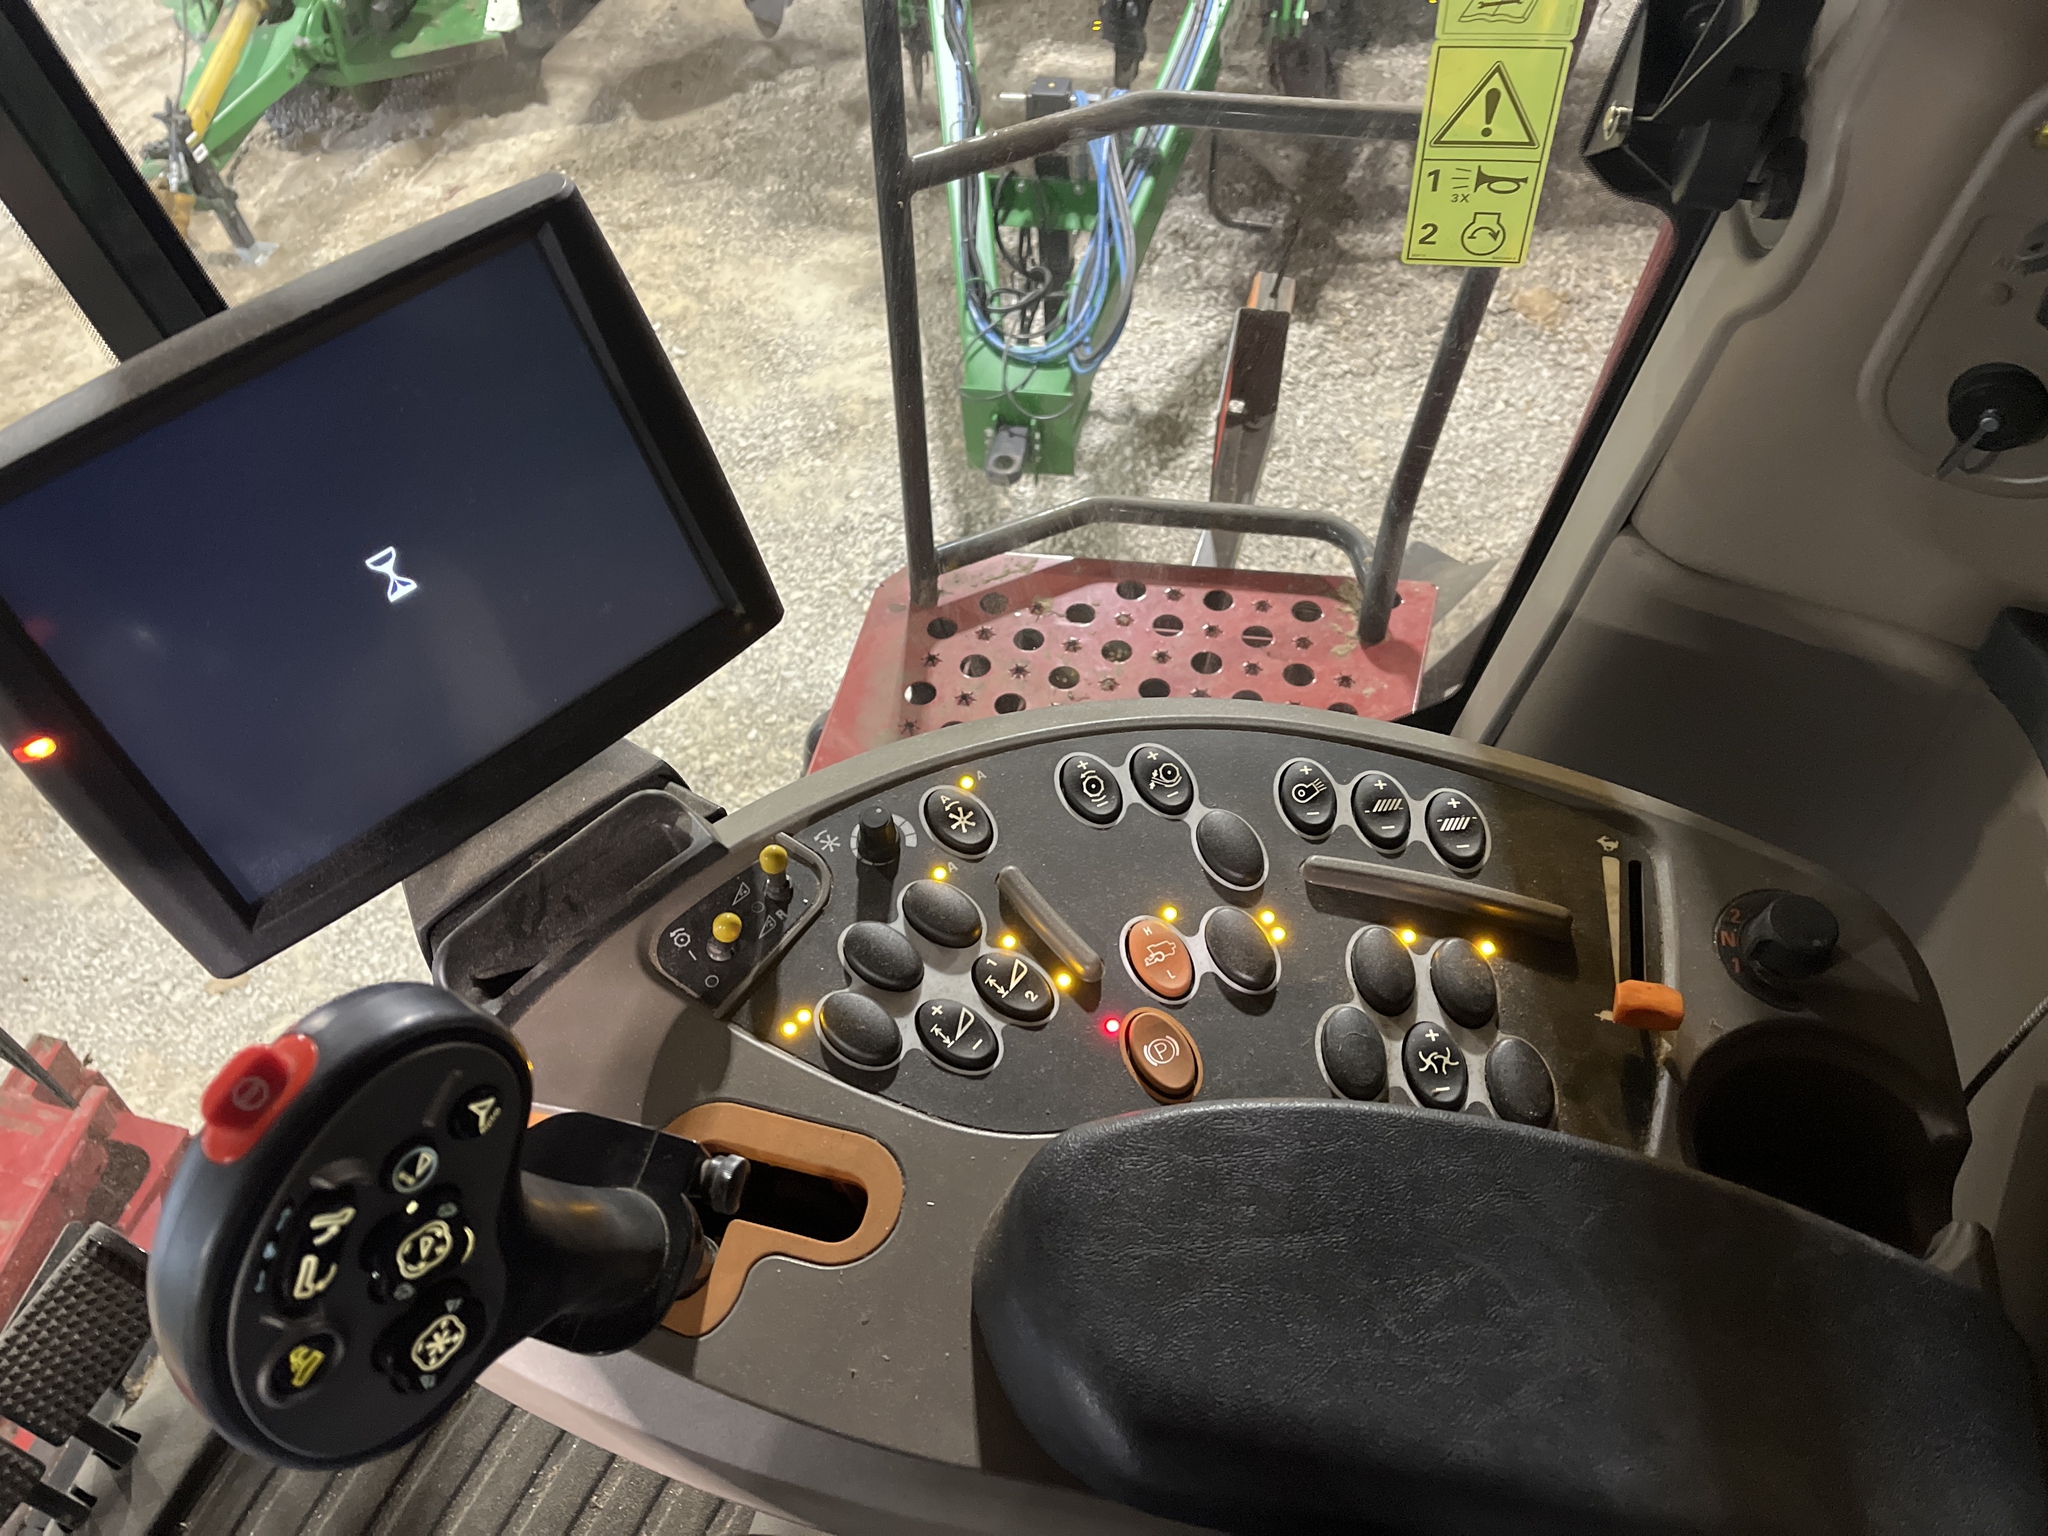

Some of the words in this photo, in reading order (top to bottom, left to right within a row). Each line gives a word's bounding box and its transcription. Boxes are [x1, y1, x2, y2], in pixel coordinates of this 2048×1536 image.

[1427, 168, 1441, 192] 1
[1451, 193, 1470, 203] 3X
[1418, 223, 1438, 245] 2
[977, 770, 987, 780] A
[940, 794, 951, 804] A
[947, 861, 958, 873] A
[775, 909, 788, 920] R
[1730, 908, 1741, 924] 2
[1143, 926, 1153, 936] H
[1720, 930, 1736, 947] N
[986, 958, 998, 967] 1
[1732, 957, 1740, 973] 1
[1166, 969, 1176, 979] L
[1025, 990, 1038, 1003] 2
[1153, 1042, 1168, 1060] P
